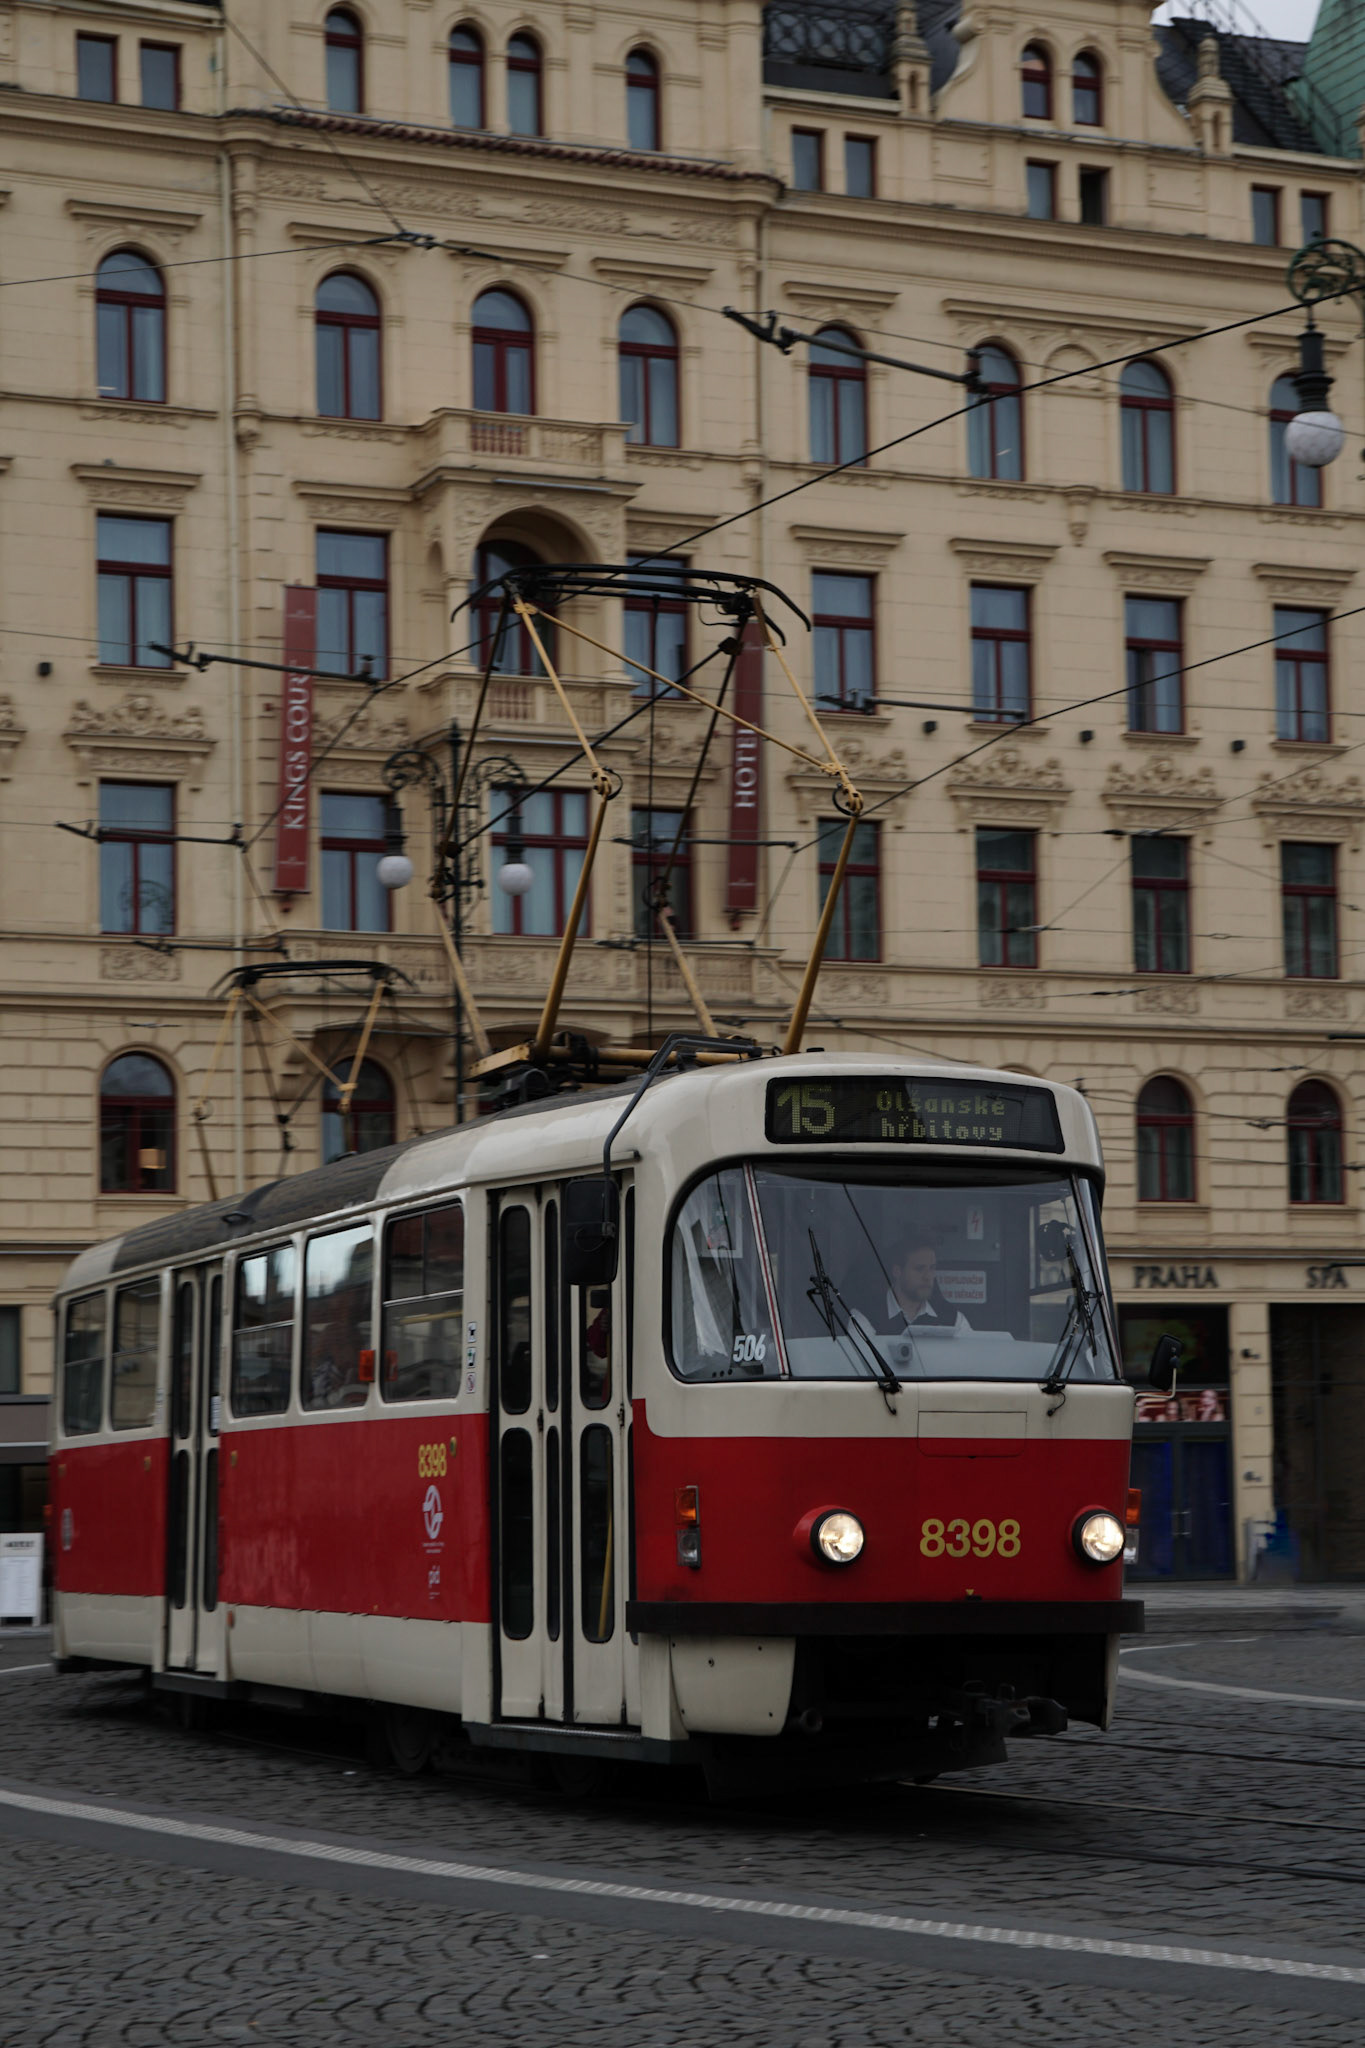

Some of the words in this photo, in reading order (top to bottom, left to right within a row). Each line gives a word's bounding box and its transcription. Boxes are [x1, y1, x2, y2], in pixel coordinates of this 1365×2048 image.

[287, 660, 309, 742] COURT
[734, 722, 758, 808] HOTEL
[284, 750, 307, 829] KINGS
[777, 1084, 836, 1135] 15
[876, 1089, 1005, 1116] Olšanské
[881, 1116, 1003, 1141] hřbitovy
[1133, 1265, 1219, 1289] PRAHA
[1306, 1266, 1349, 1289] SPA
[733, 1333, 766, 1363] 506
[419, 1443, 446, 1478] 8398
[920, 1517, 1022, 1558] 8398
